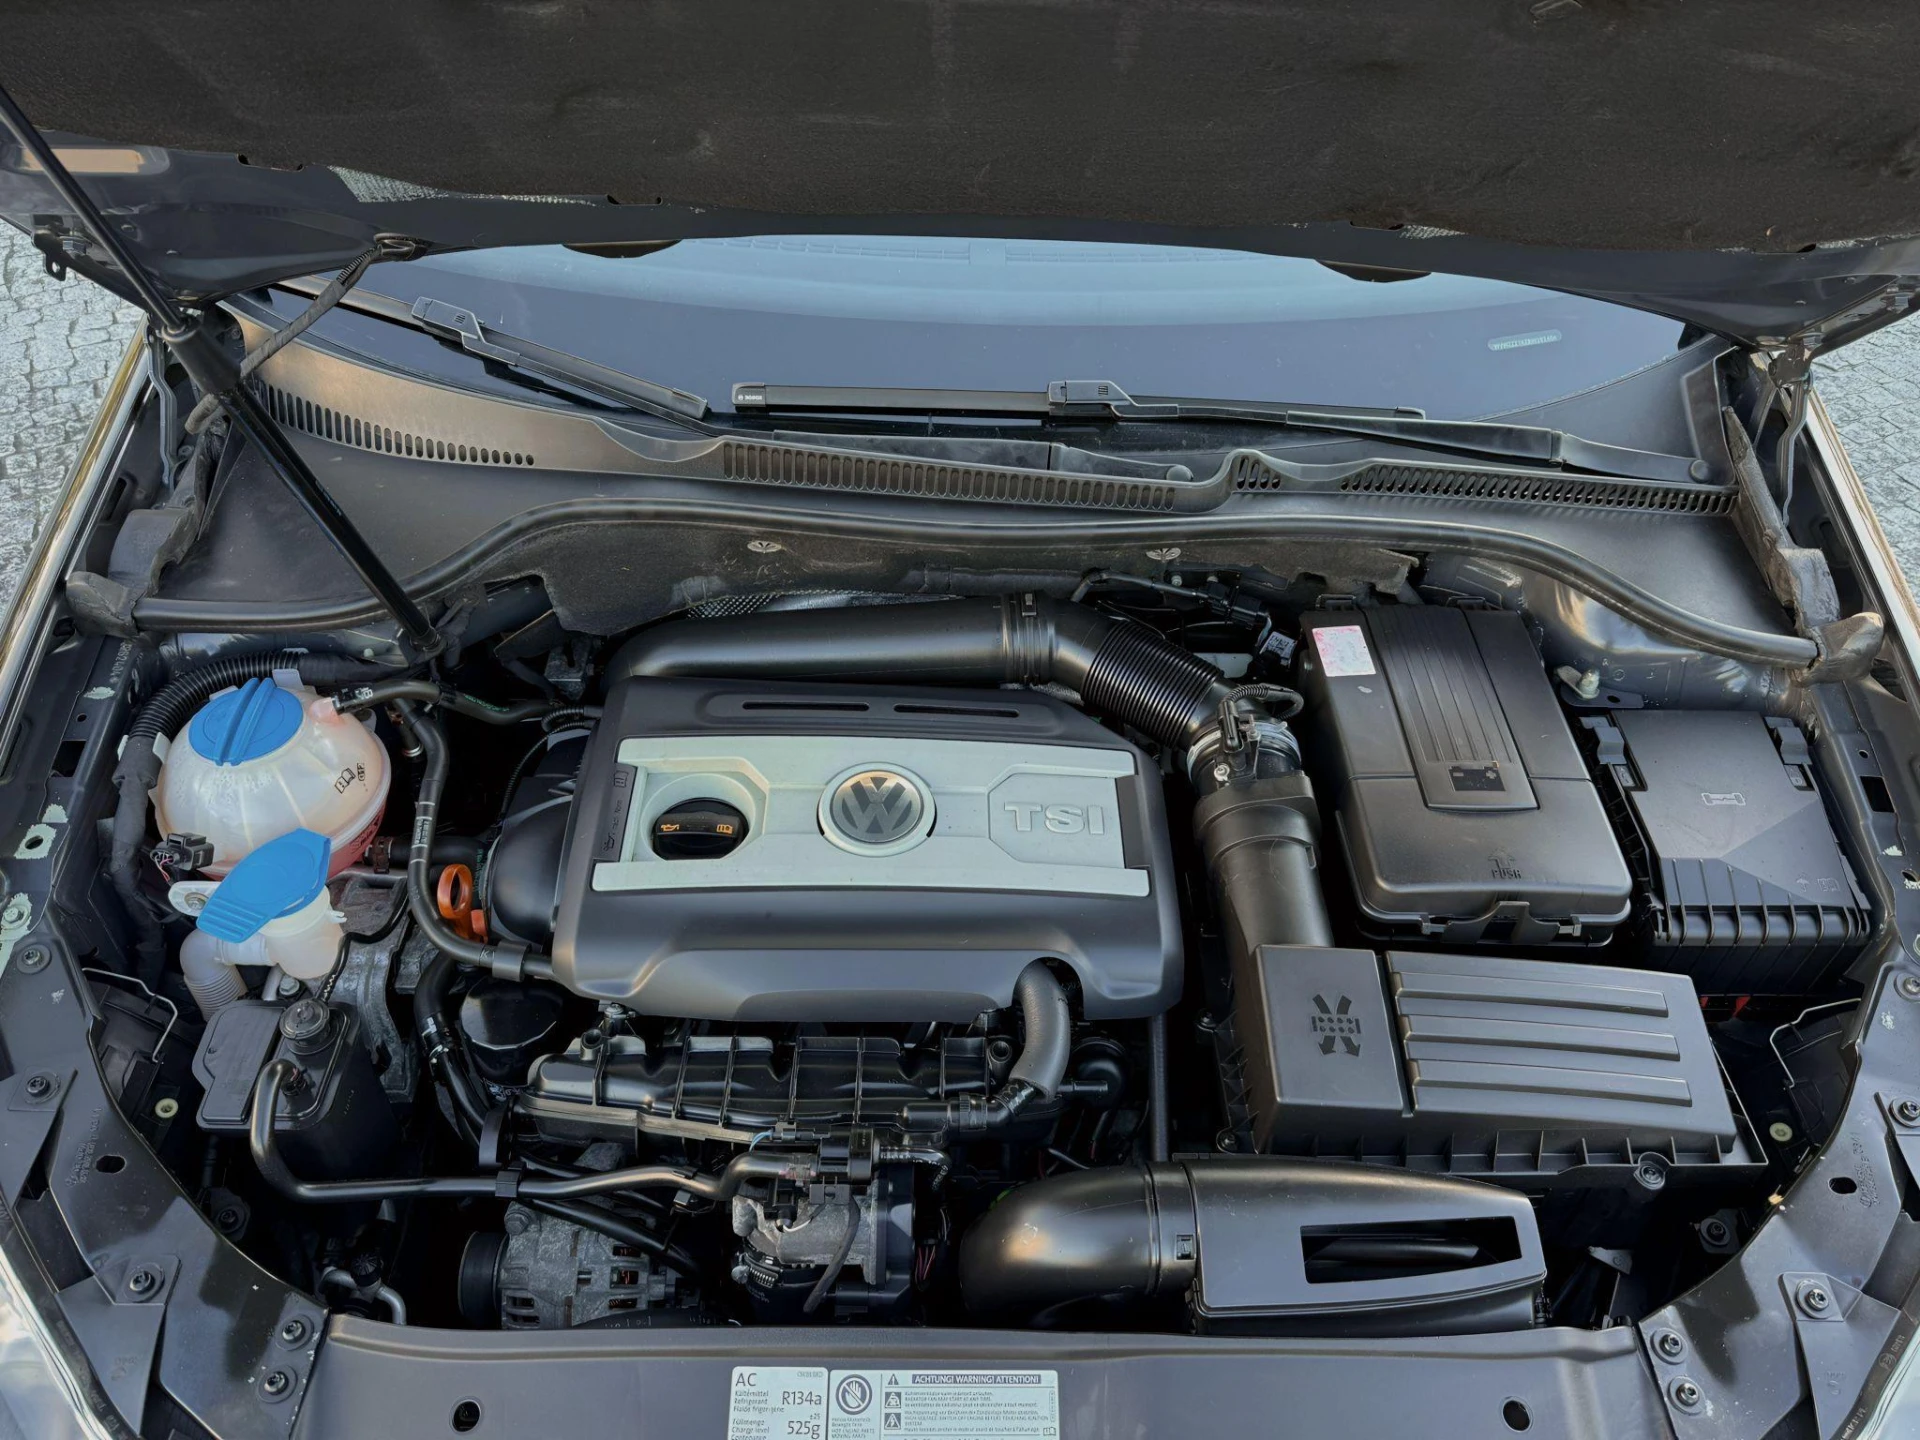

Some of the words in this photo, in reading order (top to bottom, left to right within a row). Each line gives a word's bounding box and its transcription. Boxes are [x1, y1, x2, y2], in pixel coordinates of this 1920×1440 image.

[832, 772, 921, 843] VW
[1004, 801, 1105, 835] TSI
[1491, 869, 1522, 879] PUSH
[735, 1372, 757, 1387] AC
[914, 1374, 954, 1384] ACHTUNG!
[955, 1374, 995, 1384] WARNING!
[996, 1374, 1040, 1384] ATTENTION!
[782, 1390, 822, 1405] R134a
[787, 1420, 821, 1440] 525g
